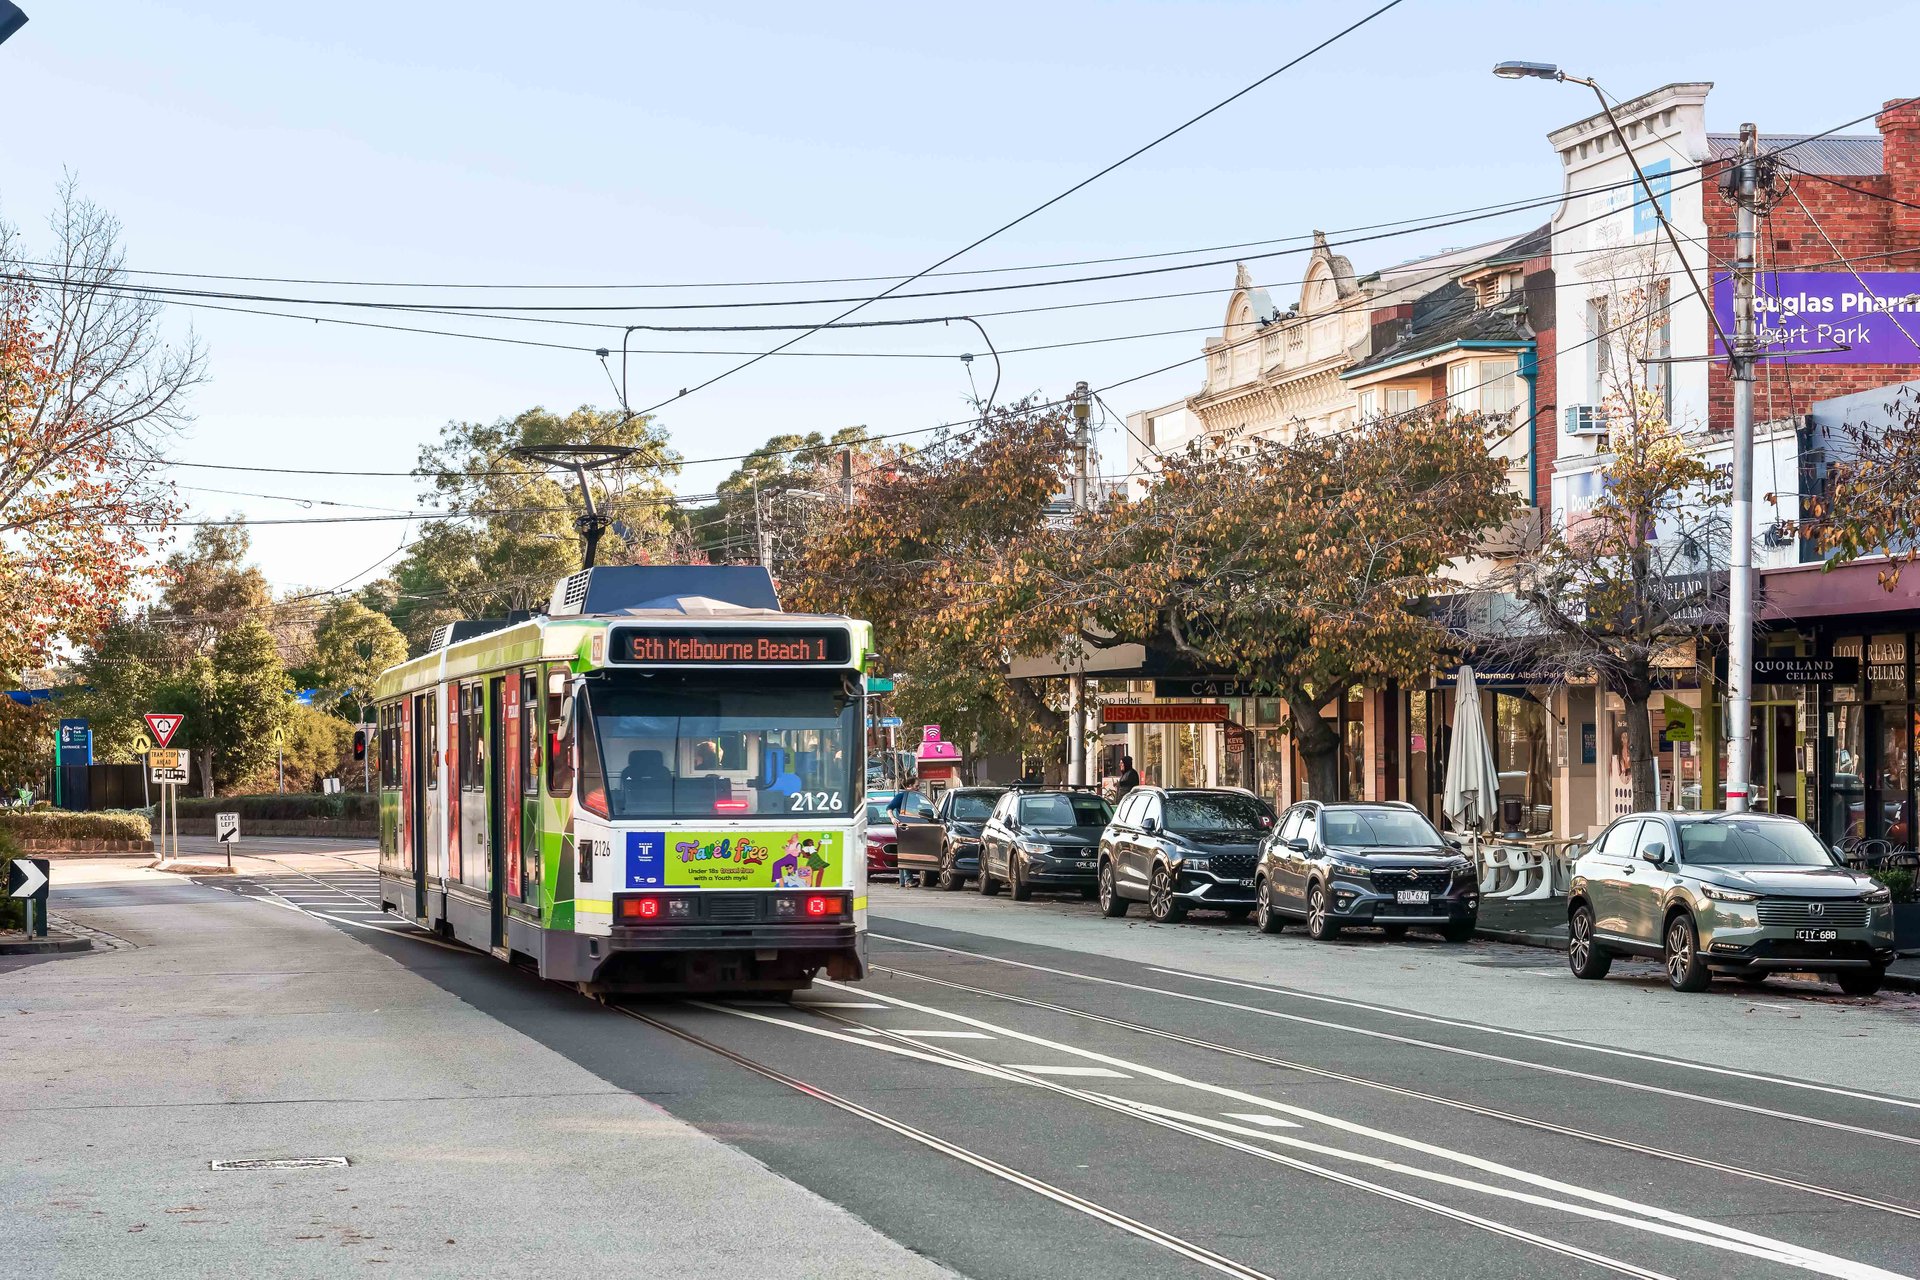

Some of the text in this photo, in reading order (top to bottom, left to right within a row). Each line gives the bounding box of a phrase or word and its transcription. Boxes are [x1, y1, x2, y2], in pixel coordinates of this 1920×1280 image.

[1734, 323, 1871, 344] lbert Park
[633, 638, 826, 660] Sth Melbourne Beach 1
[1754, 661, 1834, 673] QUORLAND
[1867, 665, 1905, 680] CELLARS
[1786, 672, 1834, 680] CELLARS
[1118, 697, 1142, 705] HOME
[1105, 706, 1227, 721] BISBAS HARDWARE
[1227, 737, 1244, 745] KEYS
[1229, 744, 1242, 752] CUT
[791, 791, 843, 812] 2126
[1262, 816, 1270, 825] P
[594, 840, 610, 856] 2126
[675, 838, 769, 863] Travel free
